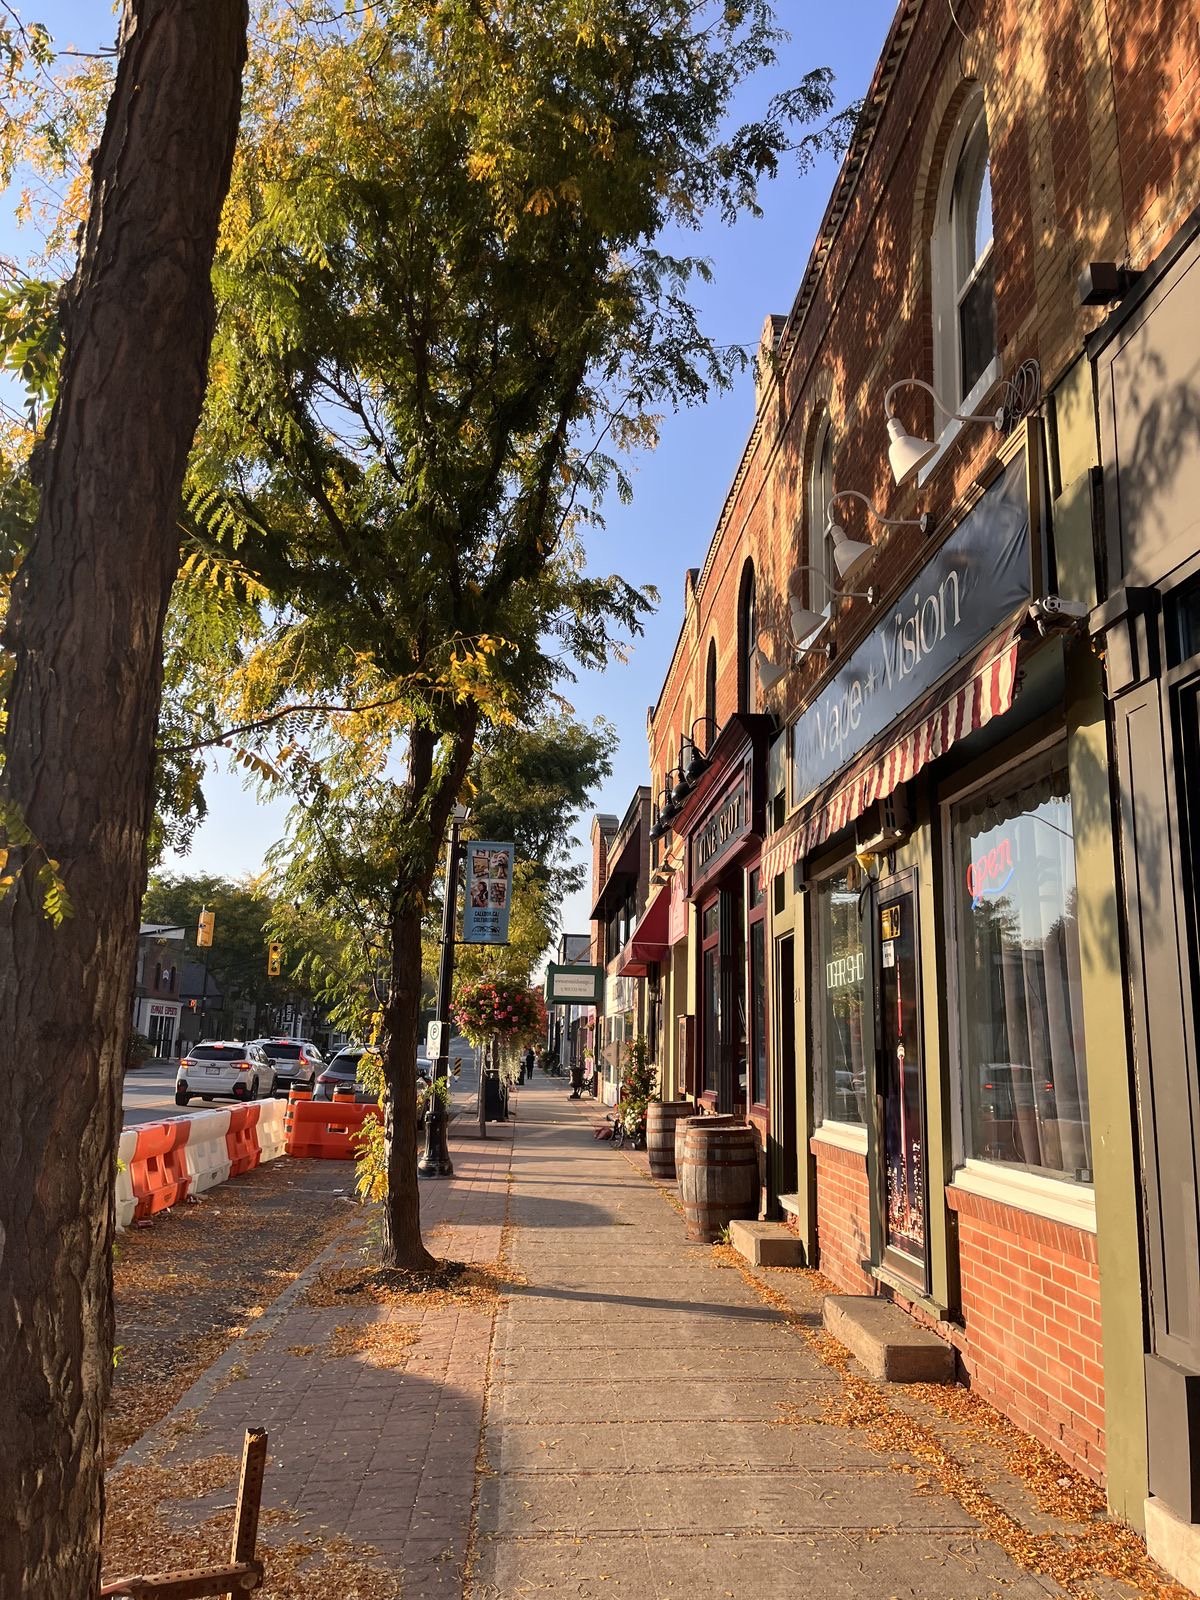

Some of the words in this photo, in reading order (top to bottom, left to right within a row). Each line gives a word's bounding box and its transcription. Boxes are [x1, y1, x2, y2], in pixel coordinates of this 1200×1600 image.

[816, 680, 862, 760] Vape
[880, 570, 960, 692] Vision
[720, 795, 740, 845] SPOT
